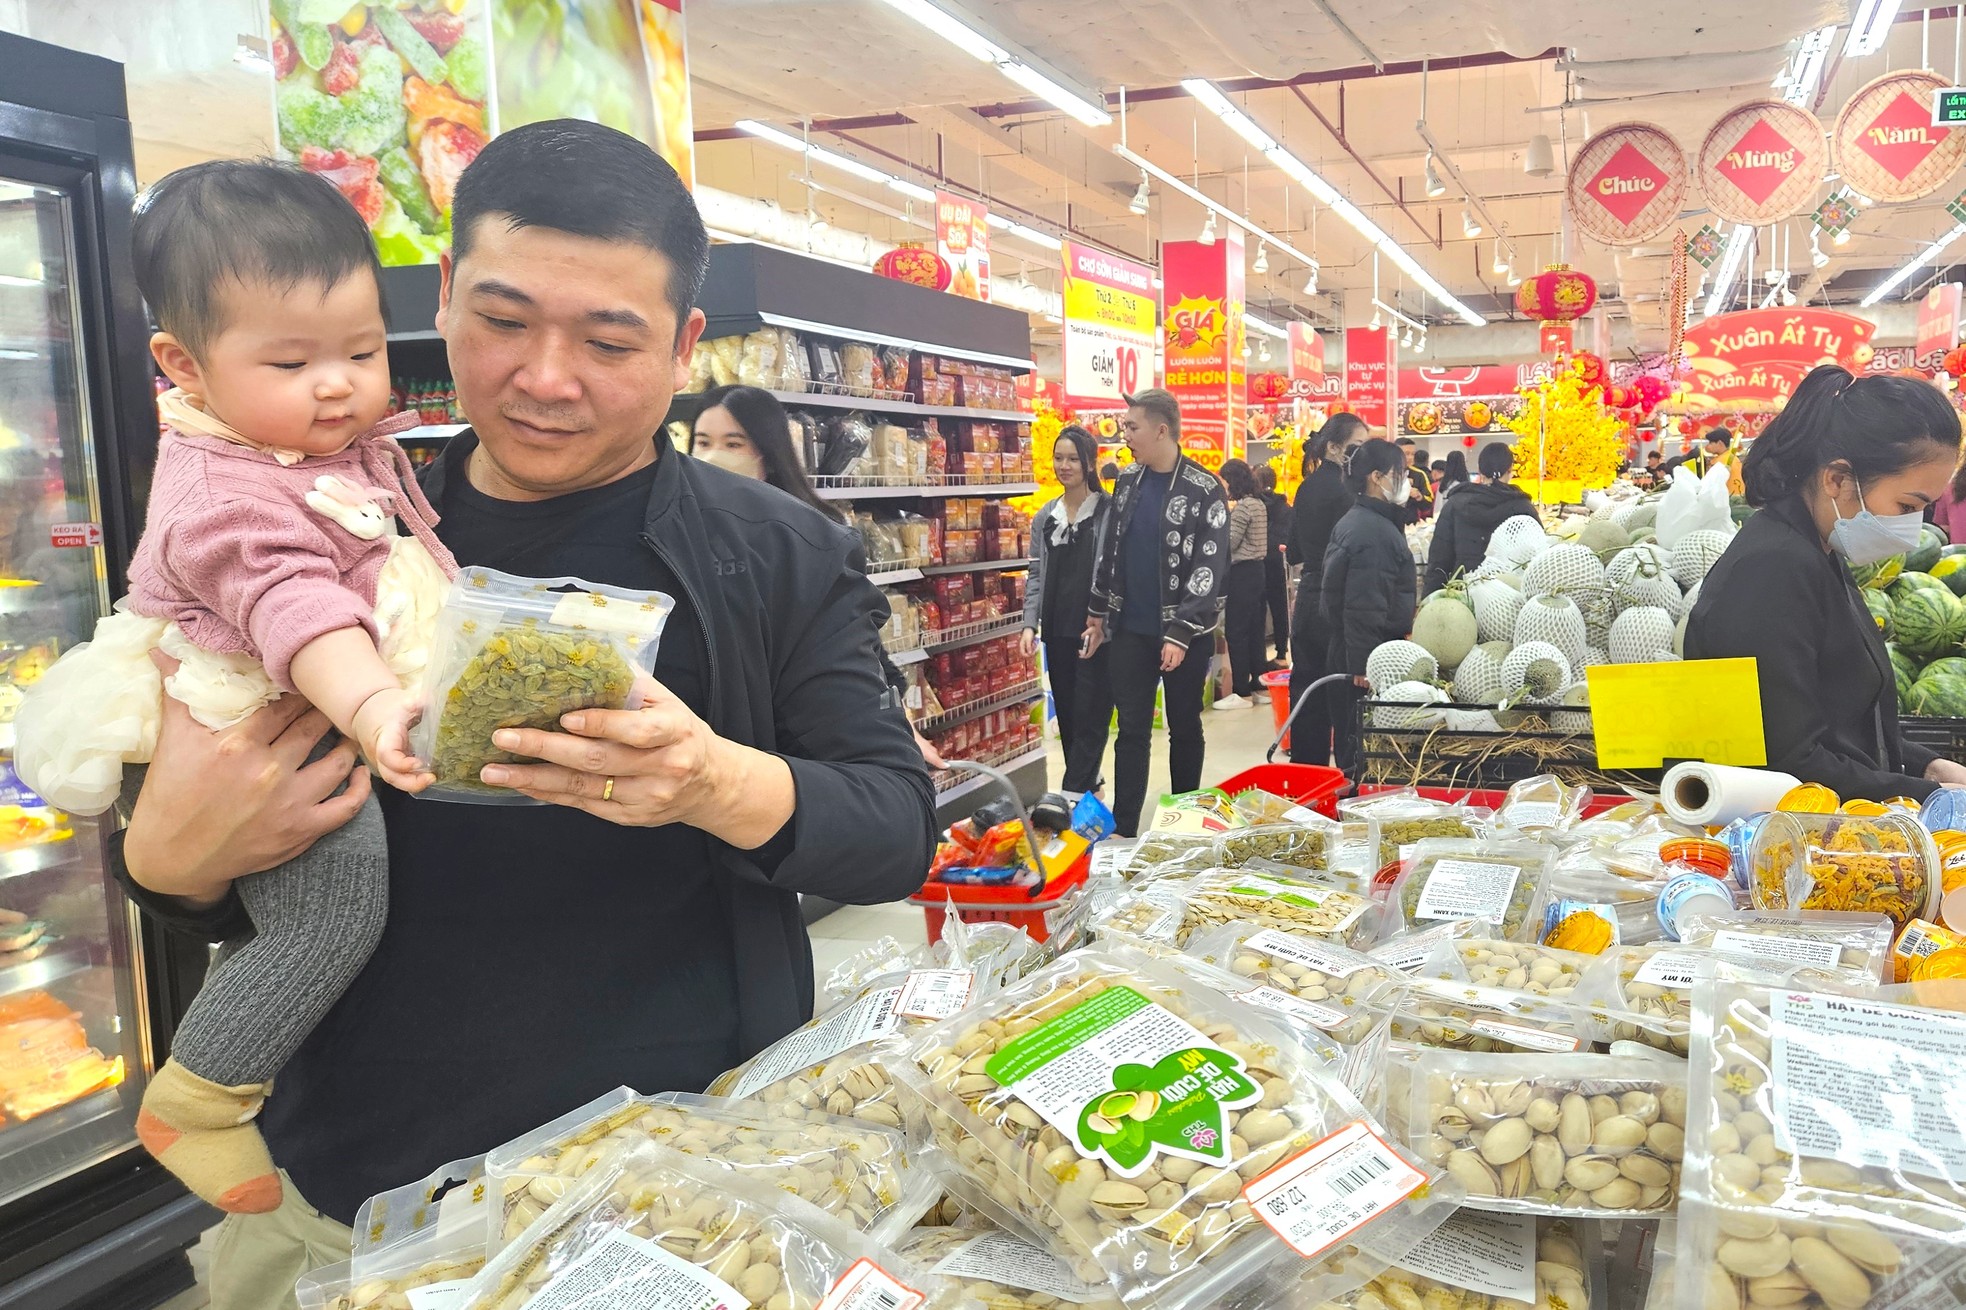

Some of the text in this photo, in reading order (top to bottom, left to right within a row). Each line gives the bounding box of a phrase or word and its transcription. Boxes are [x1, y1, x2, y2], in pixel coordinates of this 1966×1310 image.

[1868, 125, 1937, 147] Năm
[1726, 145, 1796, 173] Mừng
[1598, 175, 1656, 197] Chúc
[1175, 308, 1216, 333] GIÁ
[1710, 326, 1774, 356] Xuân
[1780, 316, 1806, 346] Ất
[1092, 349, 1114, 374] GIẢM
[1348, 362, 1386, 372] Khu vực
[1166, 368, 1226, 386] RẺ HƠN
[1350, 381, 1372, 392] phục
[1700, 374, 1746, 394] Xuân
[1748, 366, 1768, 388] Ất
[1188, 438, 1212, 450] TRÊN
[57, 537, 82, 546] OPEN
[1176, 1048, 1206, 1073] MỸ
[1158, 1074, 1202, 1103] CƯỜI
[1206, 1075, 1241, 1102] HẠT
[1266, 1186, 1307, 1216] 127.680
[1362, 1200, 1379, 1213] HAT
[1348, 1210, 1362, 1222] DE
[1326, 1220, 1348, 1235] CUOI
